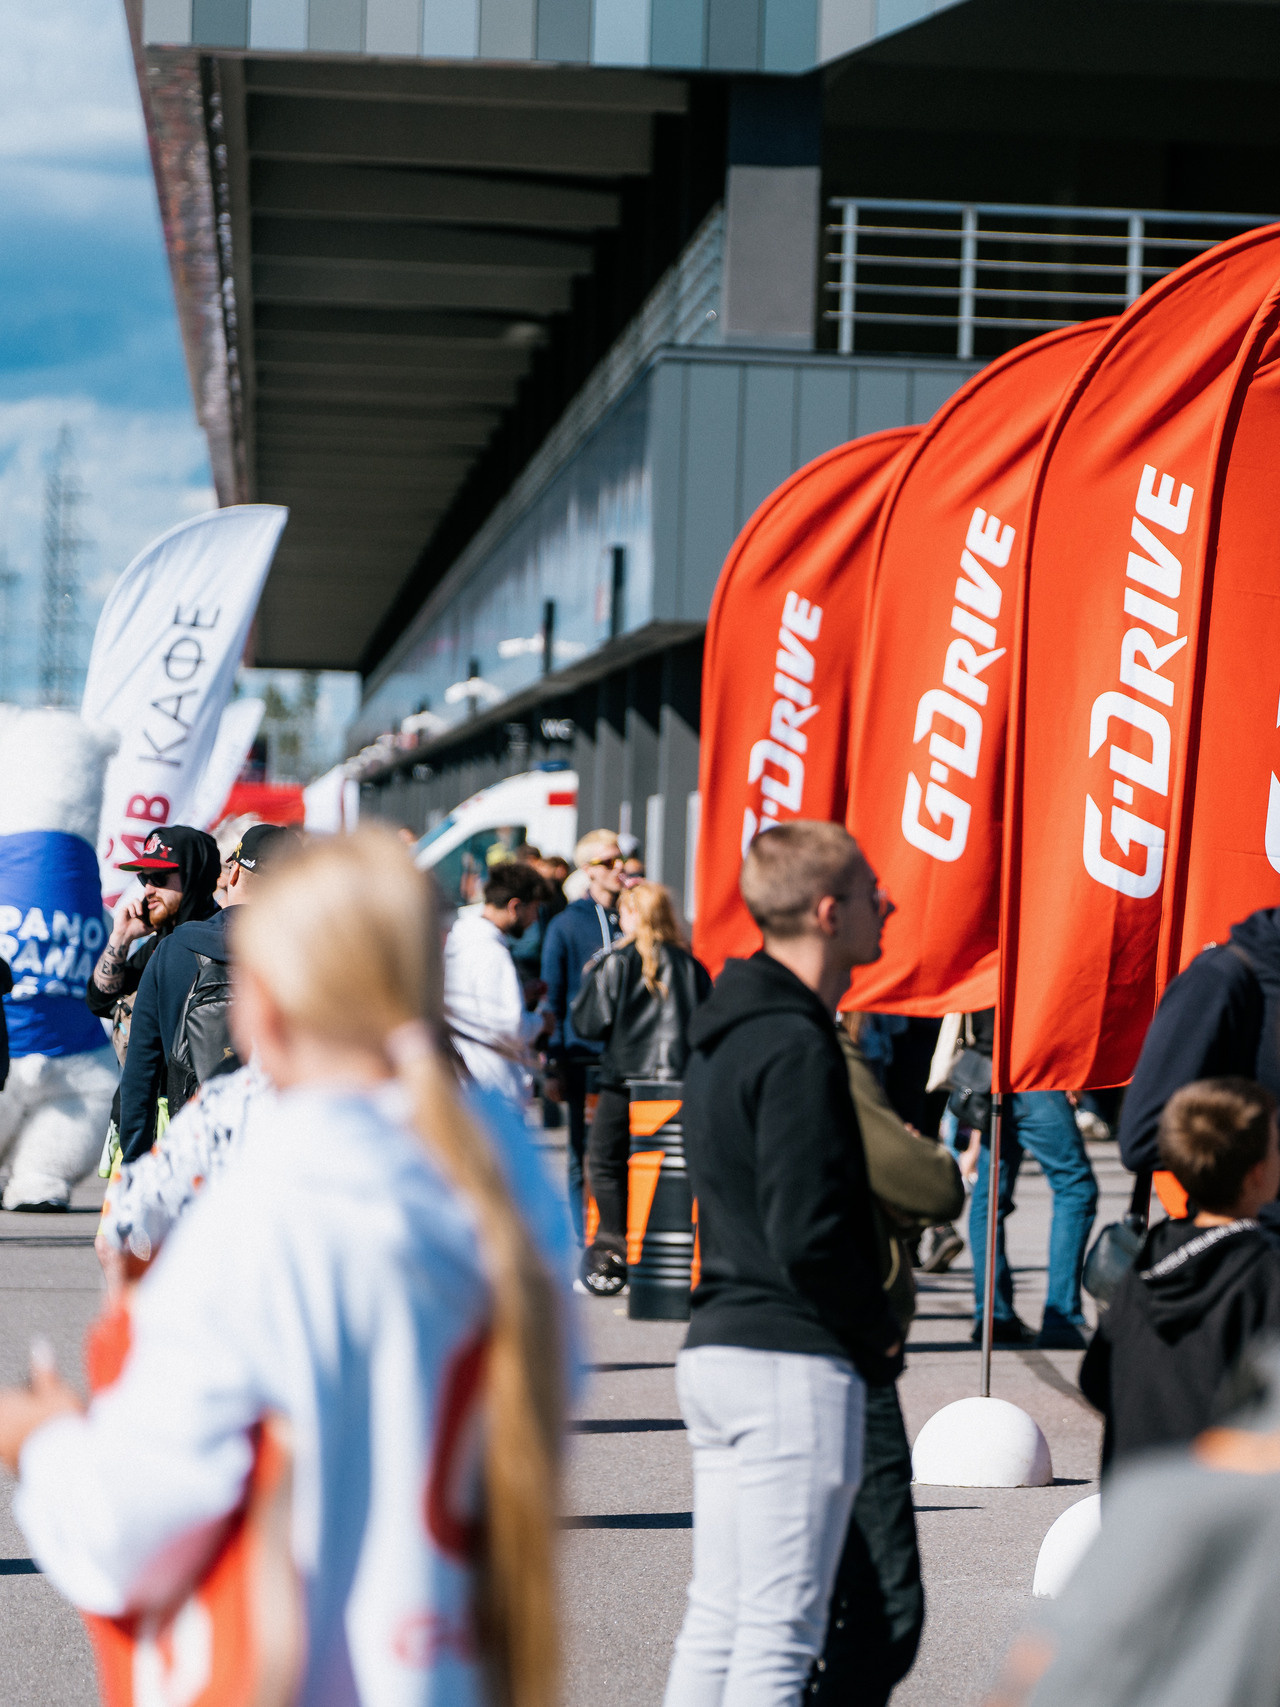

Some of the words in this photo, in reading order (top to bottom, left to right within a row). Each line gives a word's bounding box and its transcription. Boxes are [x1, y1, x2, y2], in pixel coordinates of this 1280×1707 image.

[138, 604, 221, 768] КАФЕ
[901, 506, 1017, 863] G-DRIVE
[1082, 463, 1195, 899] G-DRIVE
